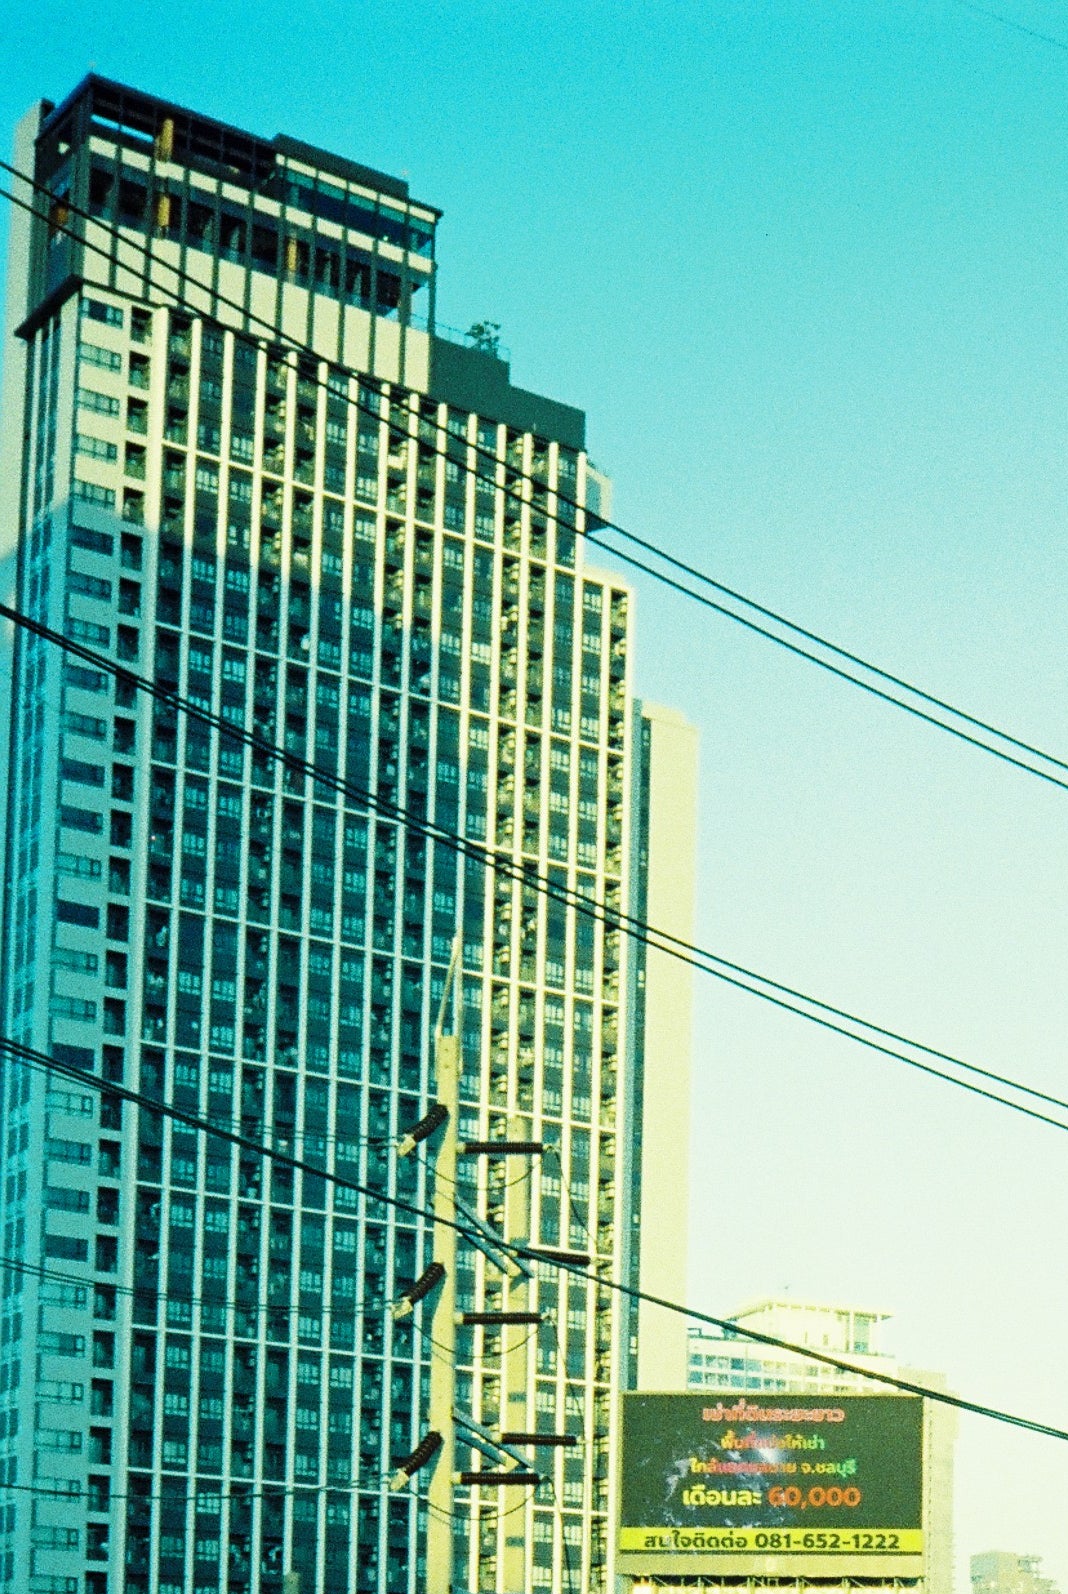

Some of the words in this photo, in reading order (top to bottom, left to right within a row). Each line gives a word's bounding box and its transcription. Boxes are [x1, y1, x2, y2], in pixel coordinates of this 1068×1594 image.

[683, 1484, 762, 1506] เดือนละ
[768, 1486, 861, 1509] 60,000
[644, 1530, 748, 1549] สนใจติดต่อ
[755, 1533, 900, 1549] 081-652-1222
